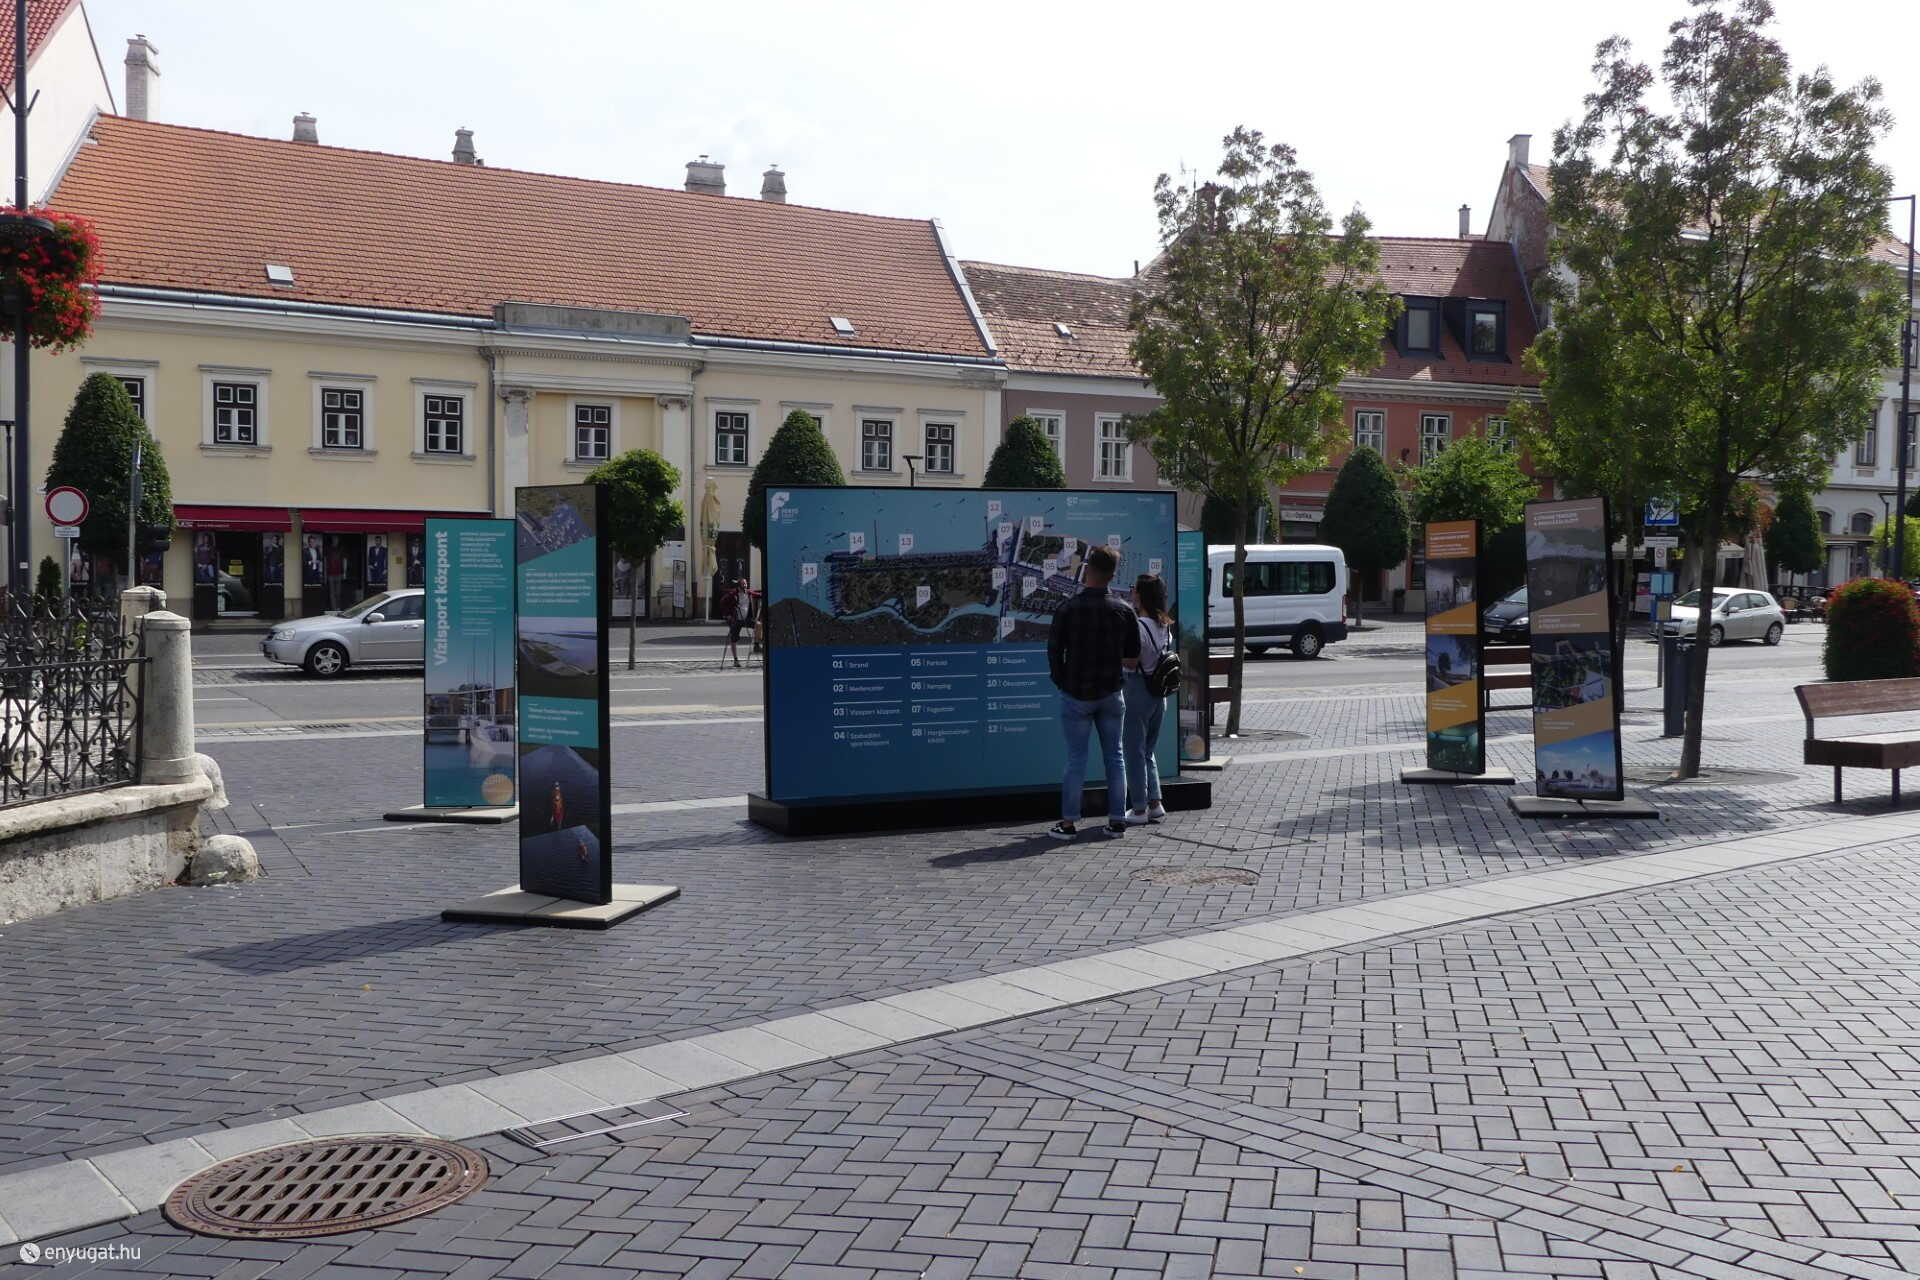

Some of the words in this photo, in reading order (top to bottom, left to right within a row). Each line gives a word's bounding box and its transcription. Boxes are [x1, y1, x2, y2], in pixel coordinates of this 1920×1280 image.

[1032, 519, 1041, 528] 01
[1000, 525, 1010, 533] 07
[853, 536, 862, 544] 14
[901, 537, 911, 545] 13
[1066, 541, 1075, 549] 02
[433, 530, 451, 595] központ
[805, 567, 814, 576] 11
[994, 569, 1004, 577] 10
[432, 597, 450, 666] Vízisport
[832, 660, 843, 669] 01
[848, 661, 869, 669] Strand
[910, 658, 921, 667] 05
[986, 680, 997, 688] 10
[833, 684, 844, 693] 02
[911, 705, 921, 713] 07
[987, 702, 997, 711] 11
[833, 708, 845, 716] 03
[987, 725, 998, 733] 12
[834, 731, 845, 740] 04
